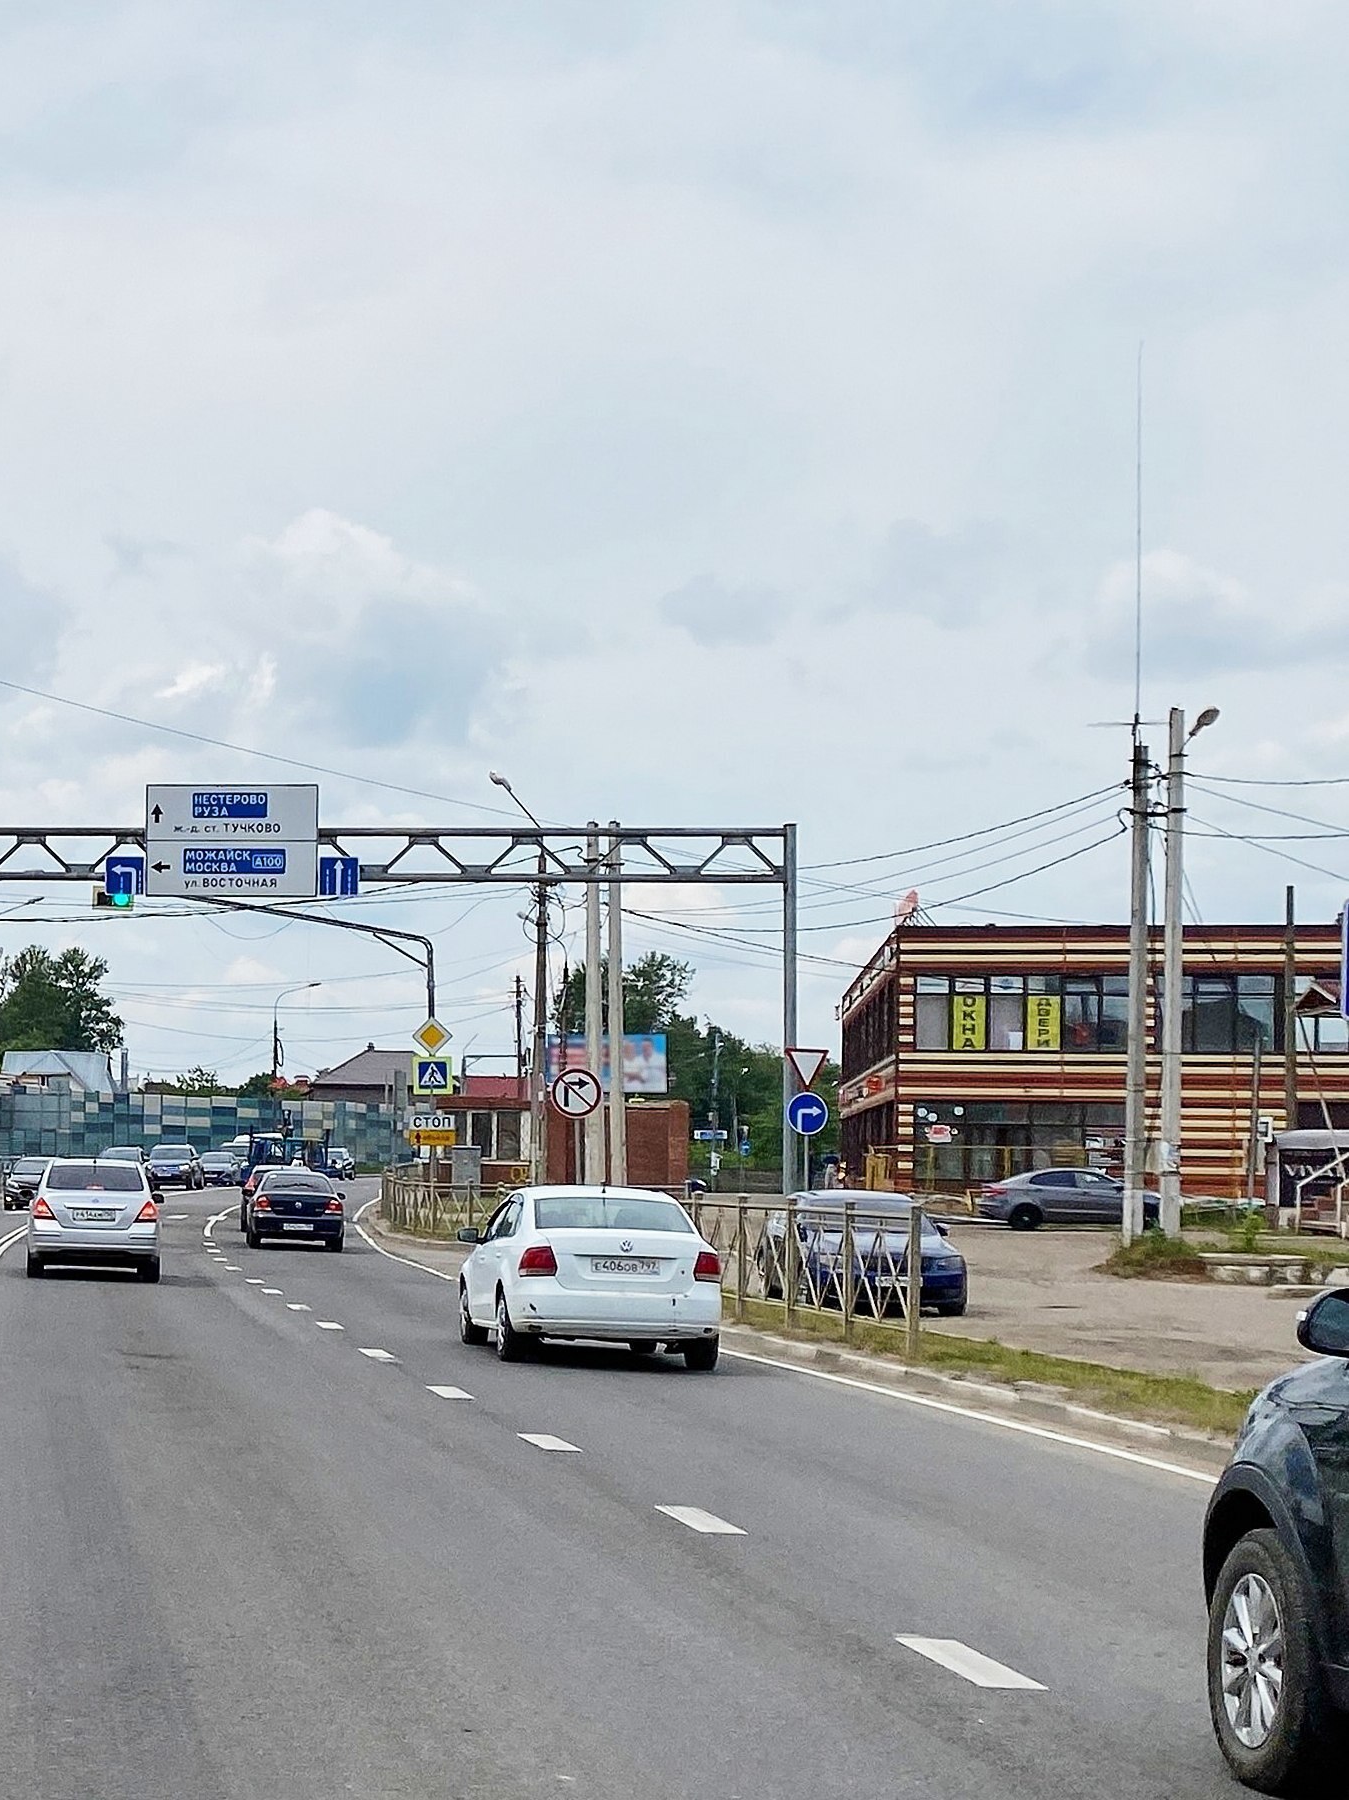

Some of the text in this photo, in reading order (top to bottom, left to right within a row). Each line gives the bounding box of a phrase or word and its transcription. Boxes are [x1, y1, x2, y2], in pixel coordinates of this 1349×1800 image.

[194, 794, 266, 805] НЕСТЕРОВО
[194, 806, 229, 816] РУЗА
[222, 822, 281, 834] ТУЧКОВО
[185, 848, 251, 861] МОЖАЙСК
[185, 862, 238, 873] МОСКВА
[202, 877, 278, 889] ВОСТОЧНАЯ
[962, 995, 977, 1049] ОКНА
[1036, 997, 1052, 1048] ДВЕРИ
[413, 1116, 451, 1128] СТОП
